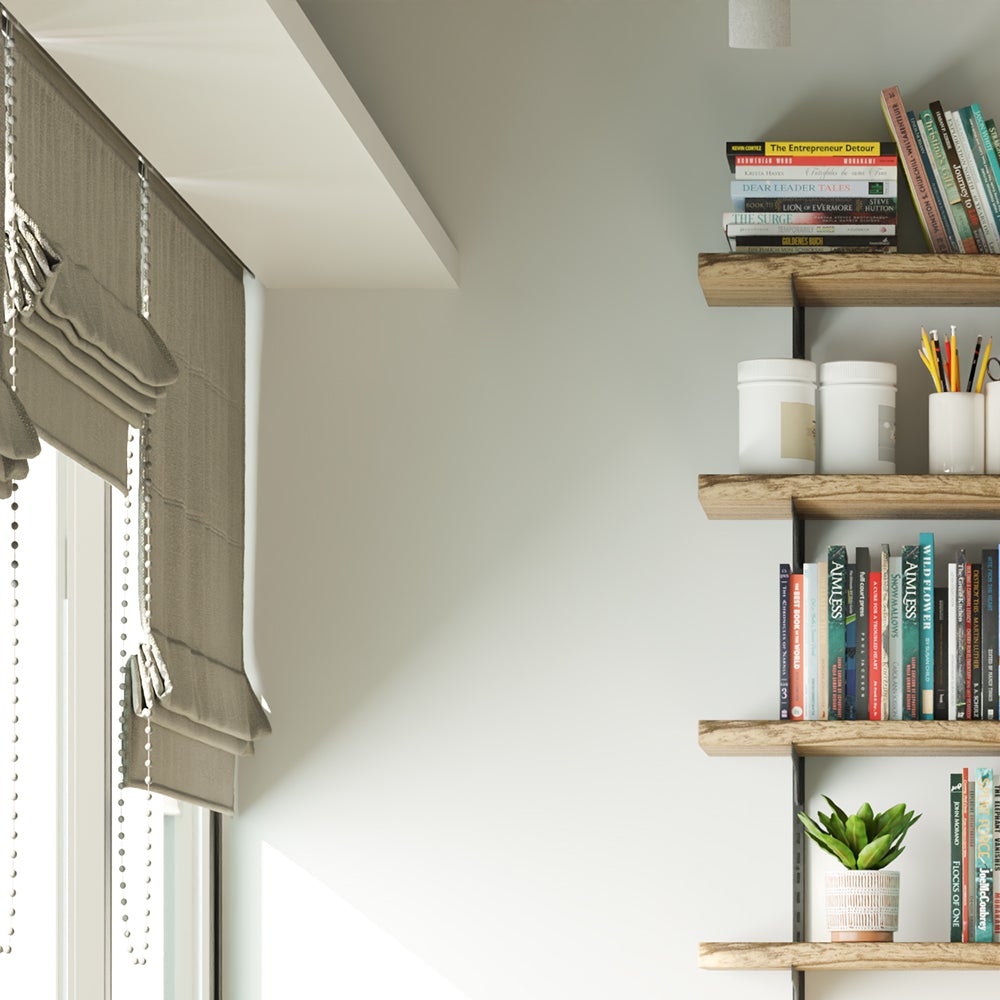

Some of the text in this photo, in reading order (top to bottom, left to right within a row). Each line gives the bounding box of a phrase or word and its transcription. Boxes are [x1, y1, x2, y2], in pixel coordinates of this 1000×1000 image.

[789, 144, 843, 153] Entrepreneur
[743, 184, 770, 192] DEAR
[773, 184, 815, 192] LEADER
[909, 158, 939, 232] WINSTON CHURCHILL
[951, 162, 970, 198] Journey
[963, 198, 973, 208] to
[733, 214, 792, 224] THE SURGE
[783, 204, 801, 212] LION
[923, 545, 931, 576] WILD
[828, 560, 843, 618] AIMLESS
[902, 560, 917, 618] AIMLESS
[922, 579, 931, 629] FLOWER
[891, 574, 900, 637] SNOWMALLOWS
[977, 777, 992, 930] SPENT FORCE JoeMcCoubrey
[952, 860, 960, 892] FLOCKS
[952, 894, 959, 906] OF
[952, 908, 960, 927] ONE
